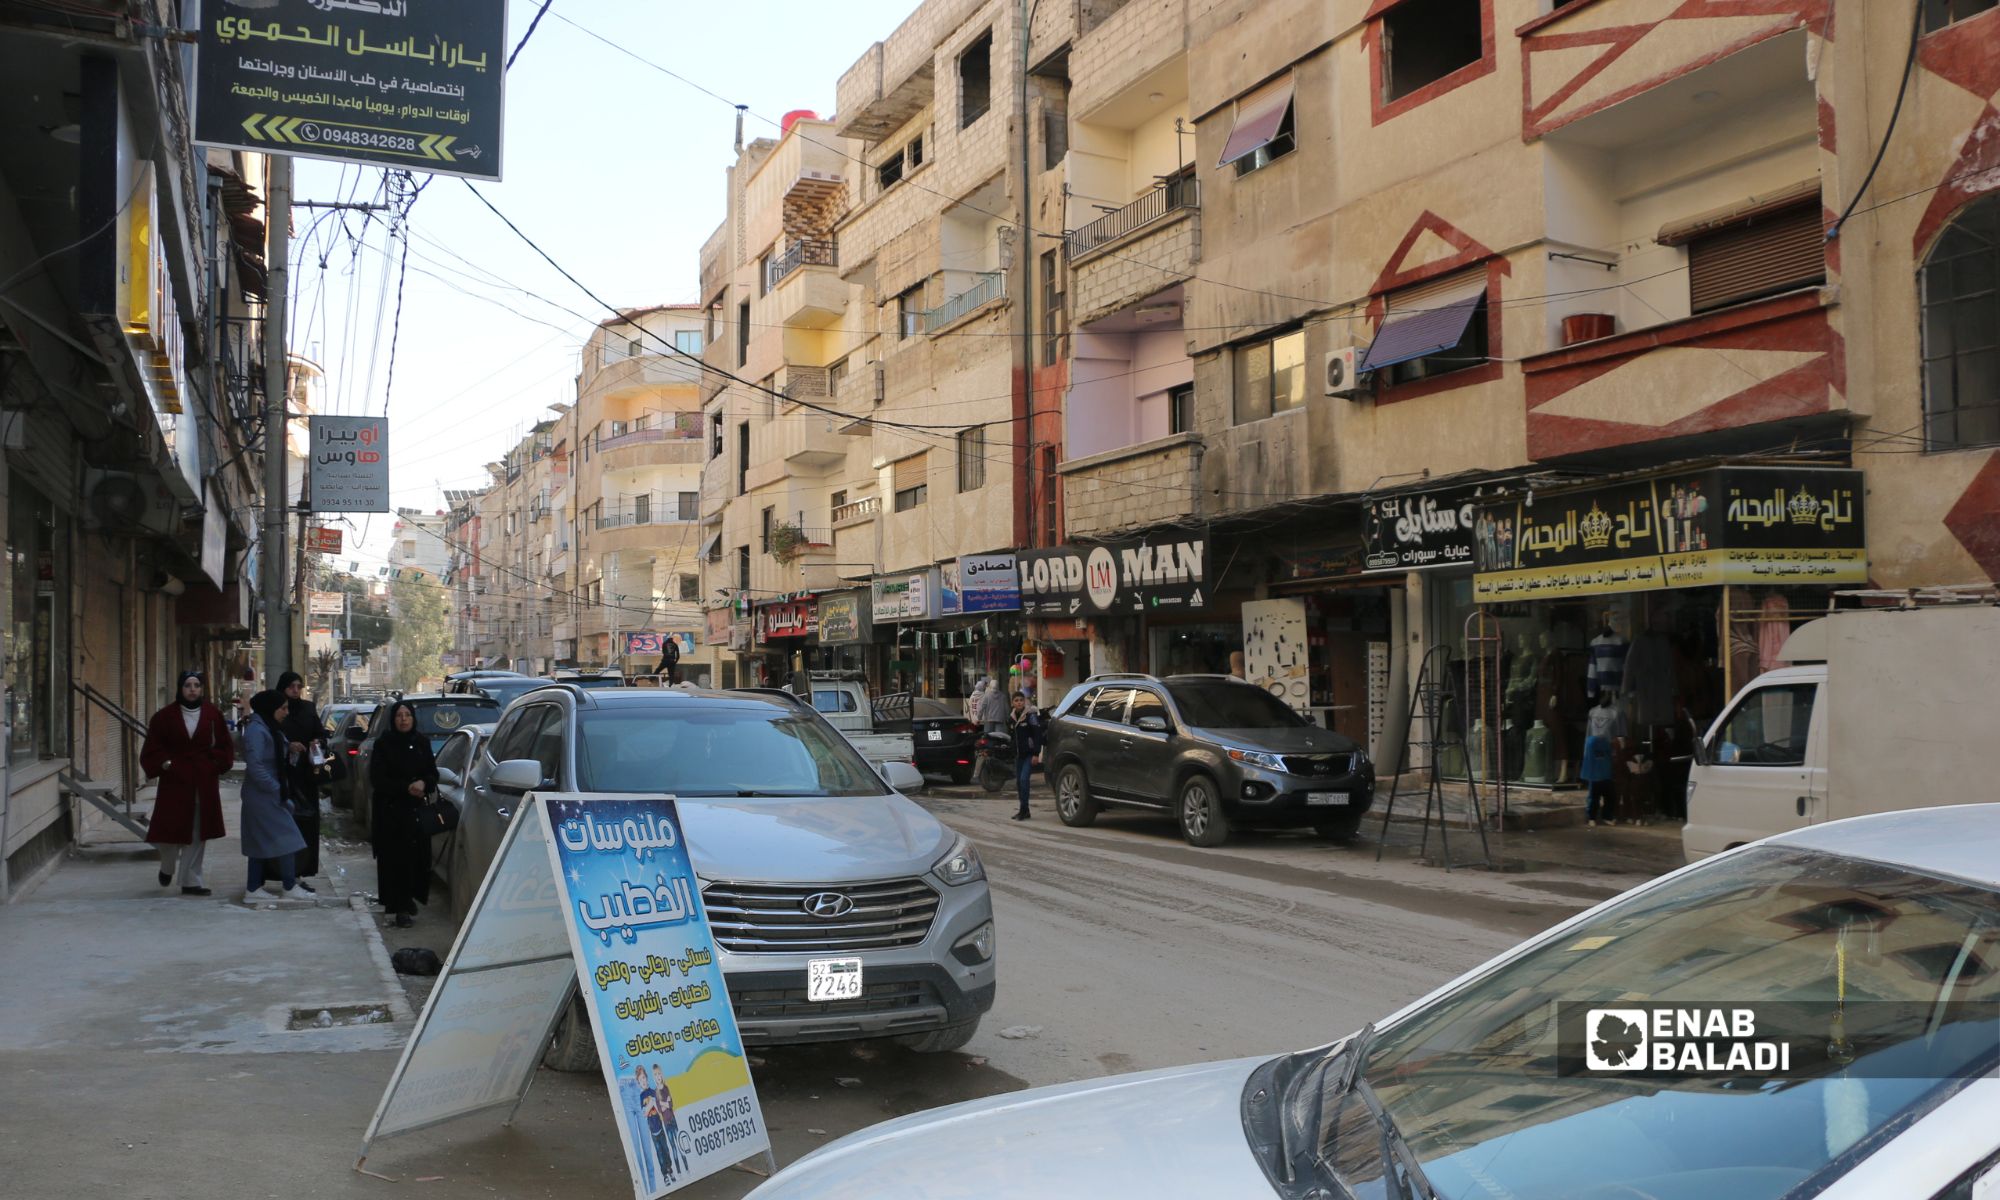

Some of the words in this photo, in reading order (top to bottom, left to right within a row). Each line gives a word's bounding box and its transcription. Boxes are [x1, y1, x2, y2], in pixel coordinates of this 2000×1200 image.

[216, 16, 339, 46] الحموي
[347, 29, 434, 66] باسل
[238, 56, 295, 79] وجراحتها
[298, 65, 347, 82] الأسنان
[350, 73, 376, 87] طب
[231, 82, 279, 101] والجمعة
[282, 92, 329, 105] الخميس
[379, 77, 398, 93] في
[332, 95, 363, 109] ماعدا
[323, 128, 415, 151] 0948342628
[317, 450, 381, 466] هاوس
[321, 498, 340, 506] 0934
[342, 498, 352, 506] 95
[1727, 488, 1785, 530] المحبة
[1820, 489, 1853, 531] تاج
[1521, 510, 1577, 558] المحبة
[1615, 500, 1651, 548] تاج
[1020, 556, 1083, 593] LORD
[1122, 540, 1203, 587] MAN
[560, 812, 676, 861] ملبوسات
[579, 875, 697, 942] الخطيب
[638, 955, 670, 984] رجالي
[677, 947, 711, 976] نسائي
[595, 961, 630, 991] ولادي
[813, 974, 859, 996] 7246
[669, 980, 711, 1008] قطنيات
[626, 1031, 674, 1057] بيجامات
[681, 1018, 720, 1042] حجابات
[688, 1096, 752, 1133] 0968636785
